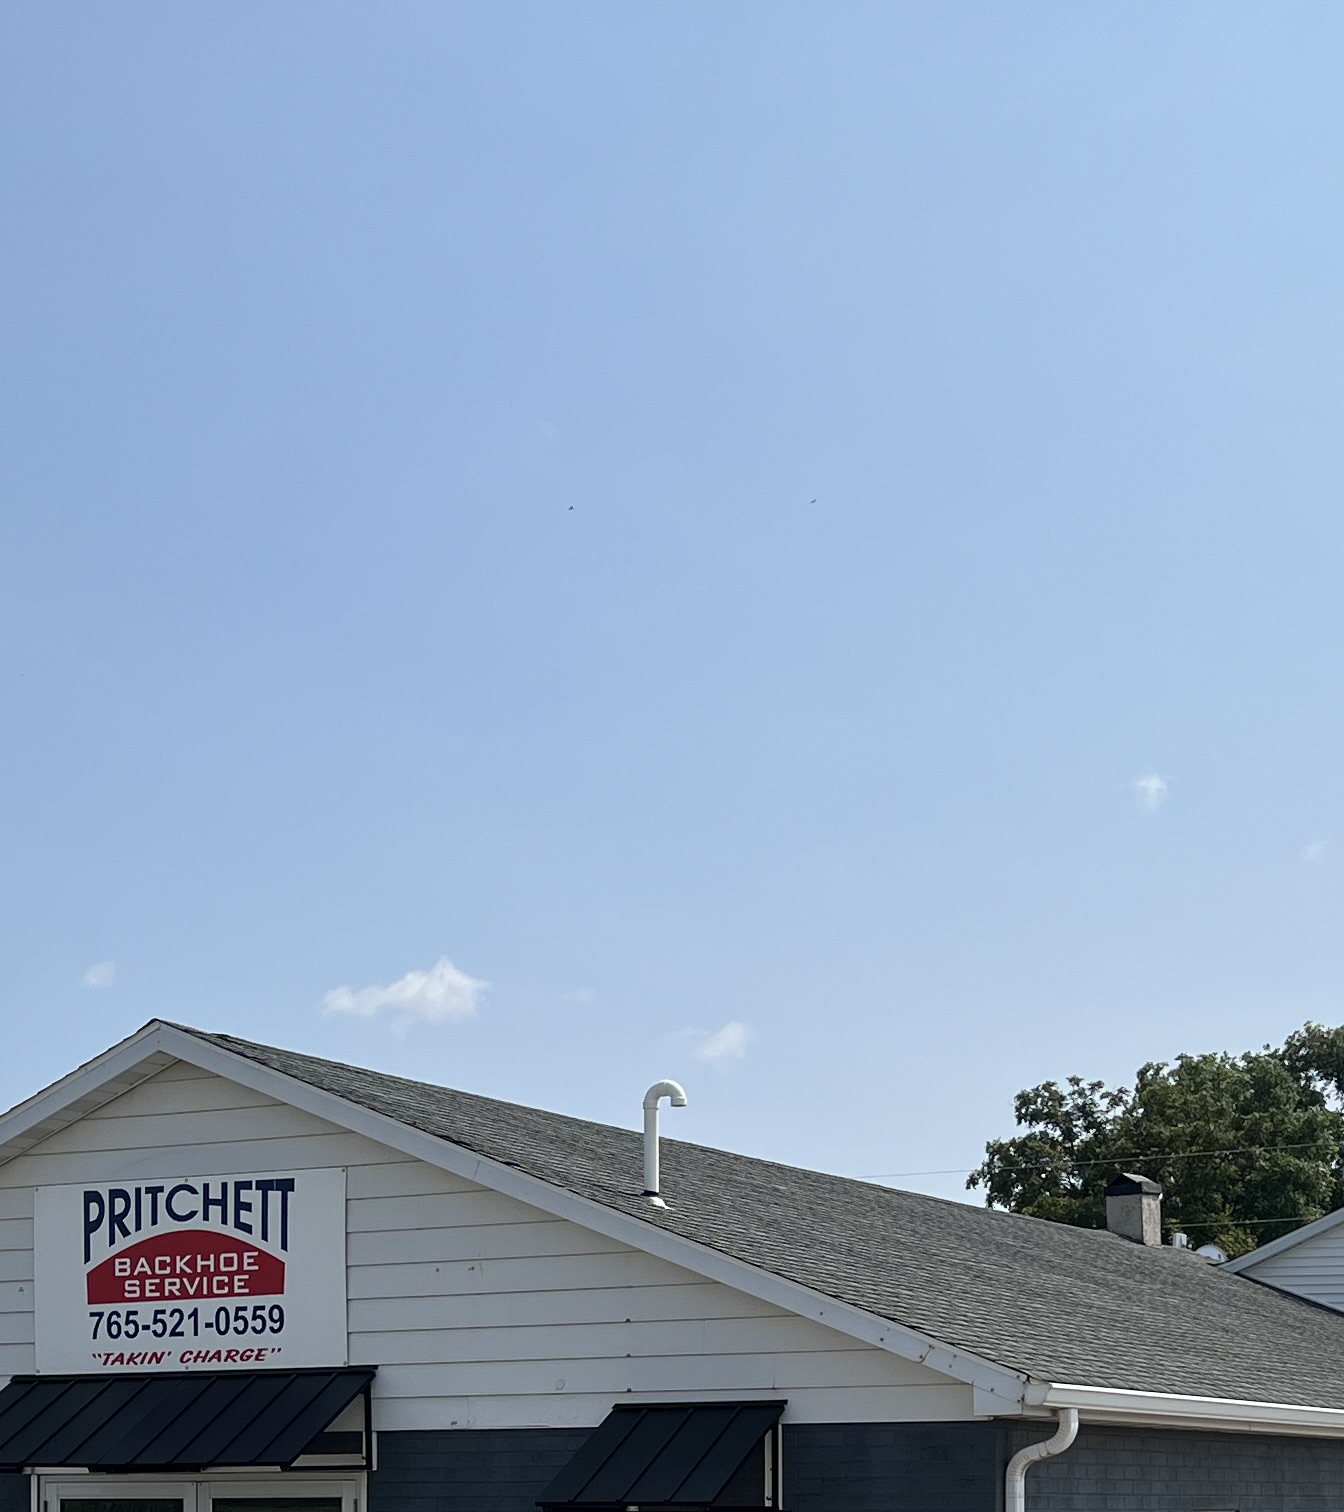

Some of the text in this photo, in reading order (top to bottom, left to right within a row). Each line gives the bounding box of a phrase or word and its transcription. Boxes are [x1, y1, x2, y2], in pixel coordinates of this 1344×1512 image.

[83, 1178, 295, 1265] PRITCHETT
[114, 1251, 259, 1277] BACKHOE
[124, 1275, 250, 1298] SERVICE
[89, 1304, 285, 1340] 765-521-0559
